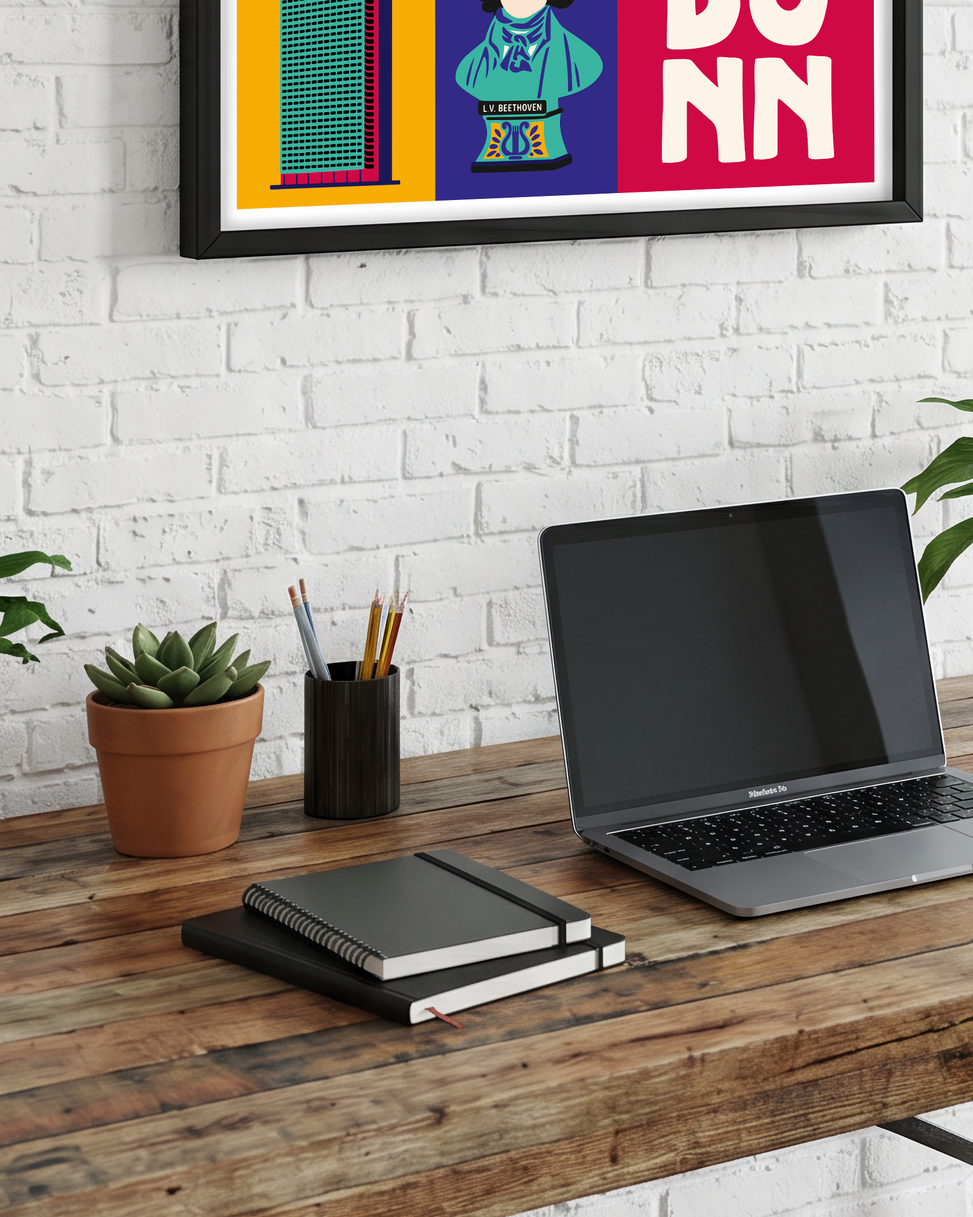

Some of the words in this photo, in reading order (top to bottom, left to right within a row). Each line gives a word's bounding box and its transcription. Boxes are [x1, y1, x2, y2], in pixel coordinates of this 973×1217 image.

[482, 104, 497, 113] L.V.
[498, 102, 543, 113] BEETHOVEN
[661, 55, 835, 164] NN
